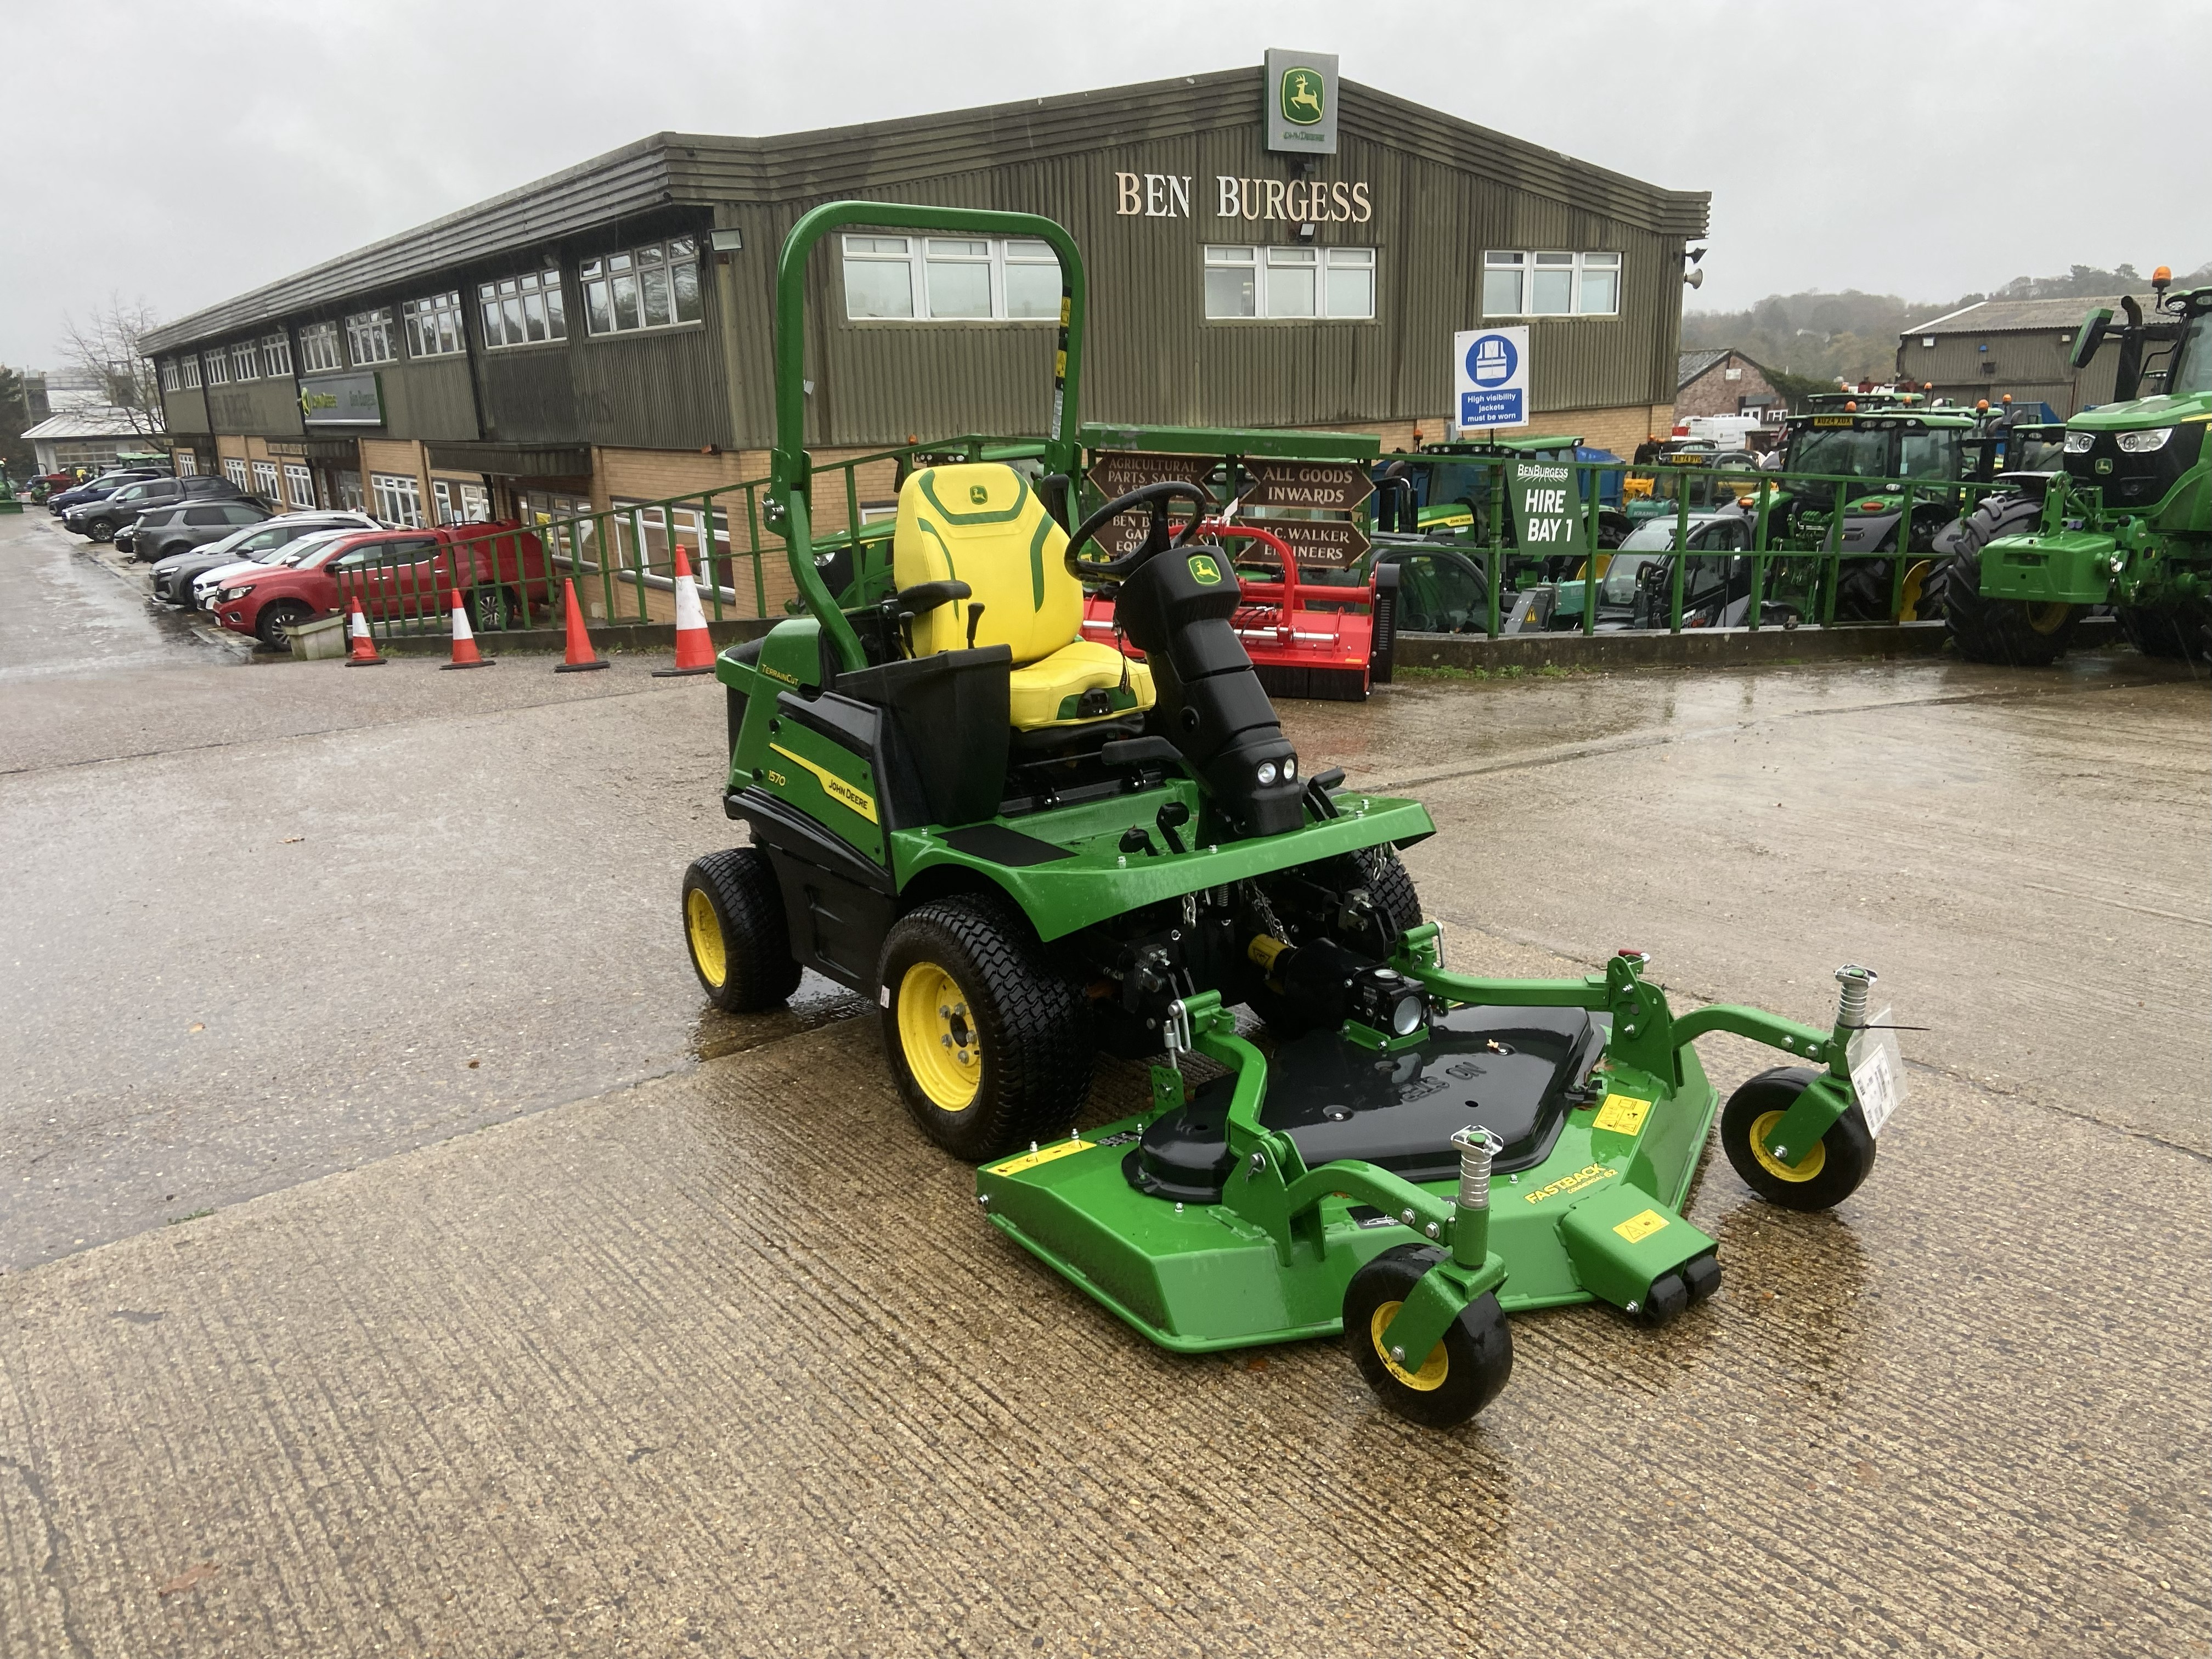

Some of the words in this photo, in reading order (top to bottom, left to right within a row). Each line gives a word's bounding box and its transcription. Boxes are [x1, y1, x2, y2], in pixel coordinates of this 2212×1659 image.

[1115, 172, 1192, 218] BEN
[1216, 176, 1372, 223] BURGESS
[1468, 394, 1484, 404] High
[1486, 393, 1516, 401] visibility
[1479, 404, 1504, 413] jackets
[1109, 458, 1198, 472] AGRICULTURAL
[1263, 466, 1295, 482] ALL
[1299, 468, 1353, 484] GOODS
[1268, 487, 1344, 504] INWARDS
[1525, 489, 1566, 513] HIRE
[1113, 515, 1136, 527] BEN
[1527, 518, 1562, 541] BAY
[1566, 519, 1573, 541] 1
[1265, 544, 1343, 561] EINEERS
[768, 770, 786, 787] 1570
[828, 779, 845, 797] JOHN
[846, 790, 868, 810] DEERE
[1603, 1169, 1619, 1178] 62
[1523, 1161, 1606, 1204] FASTBACK
